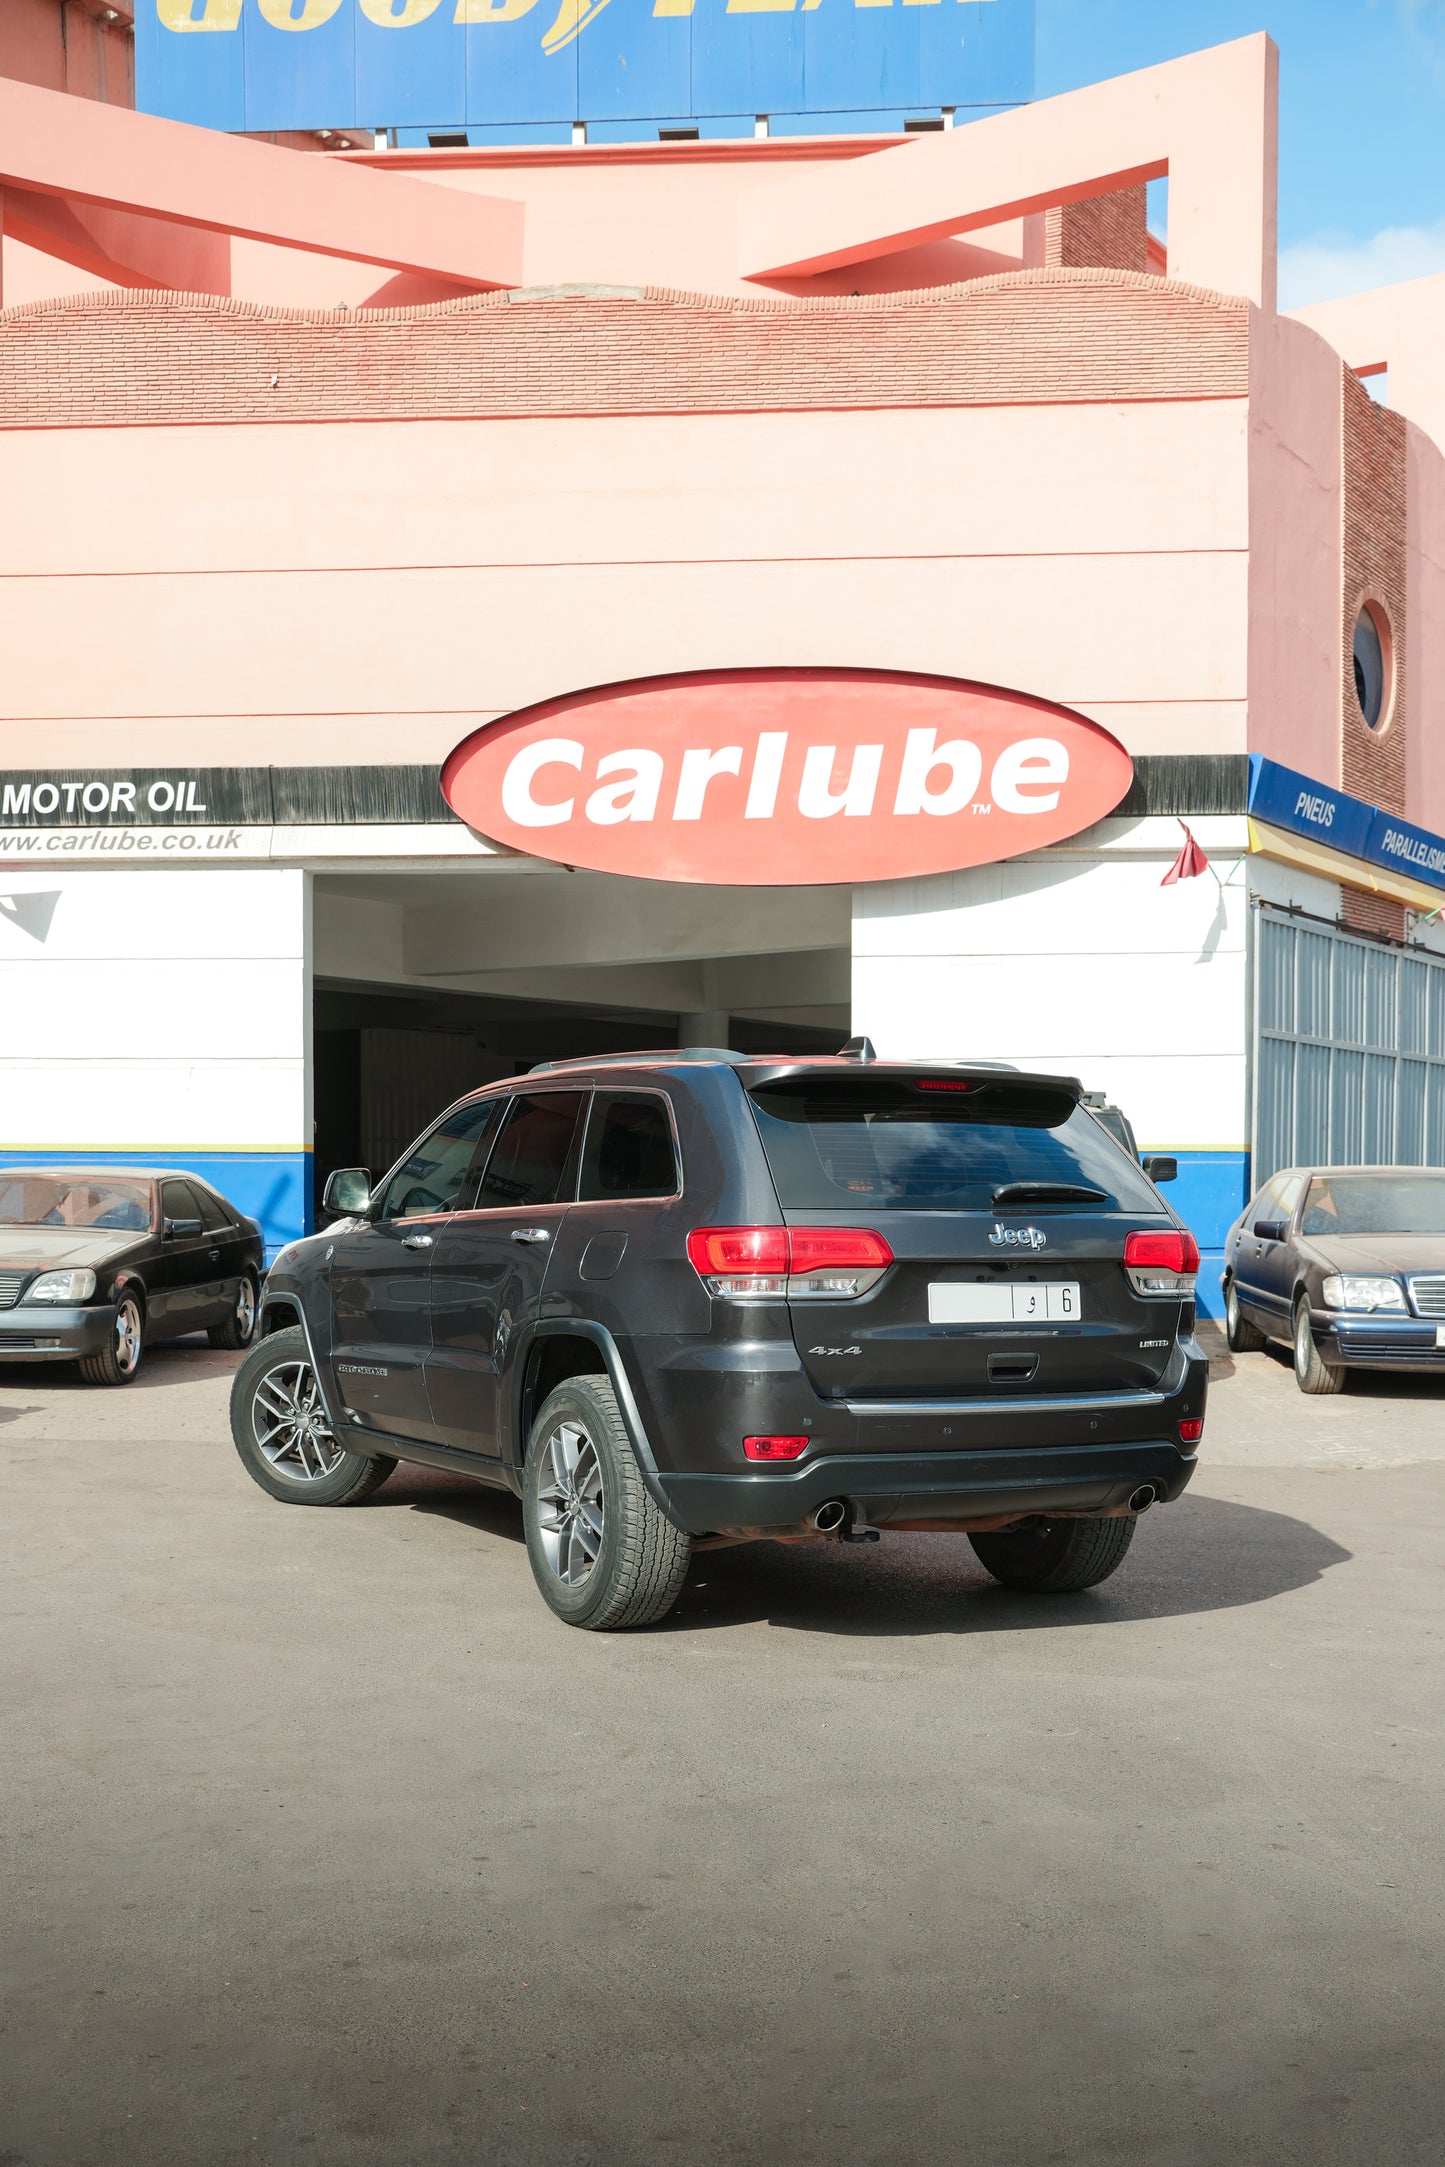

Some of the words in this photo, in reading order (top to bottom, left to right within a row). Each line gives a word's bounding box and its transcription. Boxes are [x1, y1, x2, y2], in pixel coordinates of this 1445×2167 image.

[501, 727, 1070, 827] Carlube
[2, 782, 136, 815] MOTOR
[147, 781, 207, 812] OIL
[1294, 791, 1336, 827] PNEUS
[988, 1222, 1047, 1251] Jeep
[1062, 1288, 1072, 1313] 6
[808, 1346, 862, 1356] 4x4
